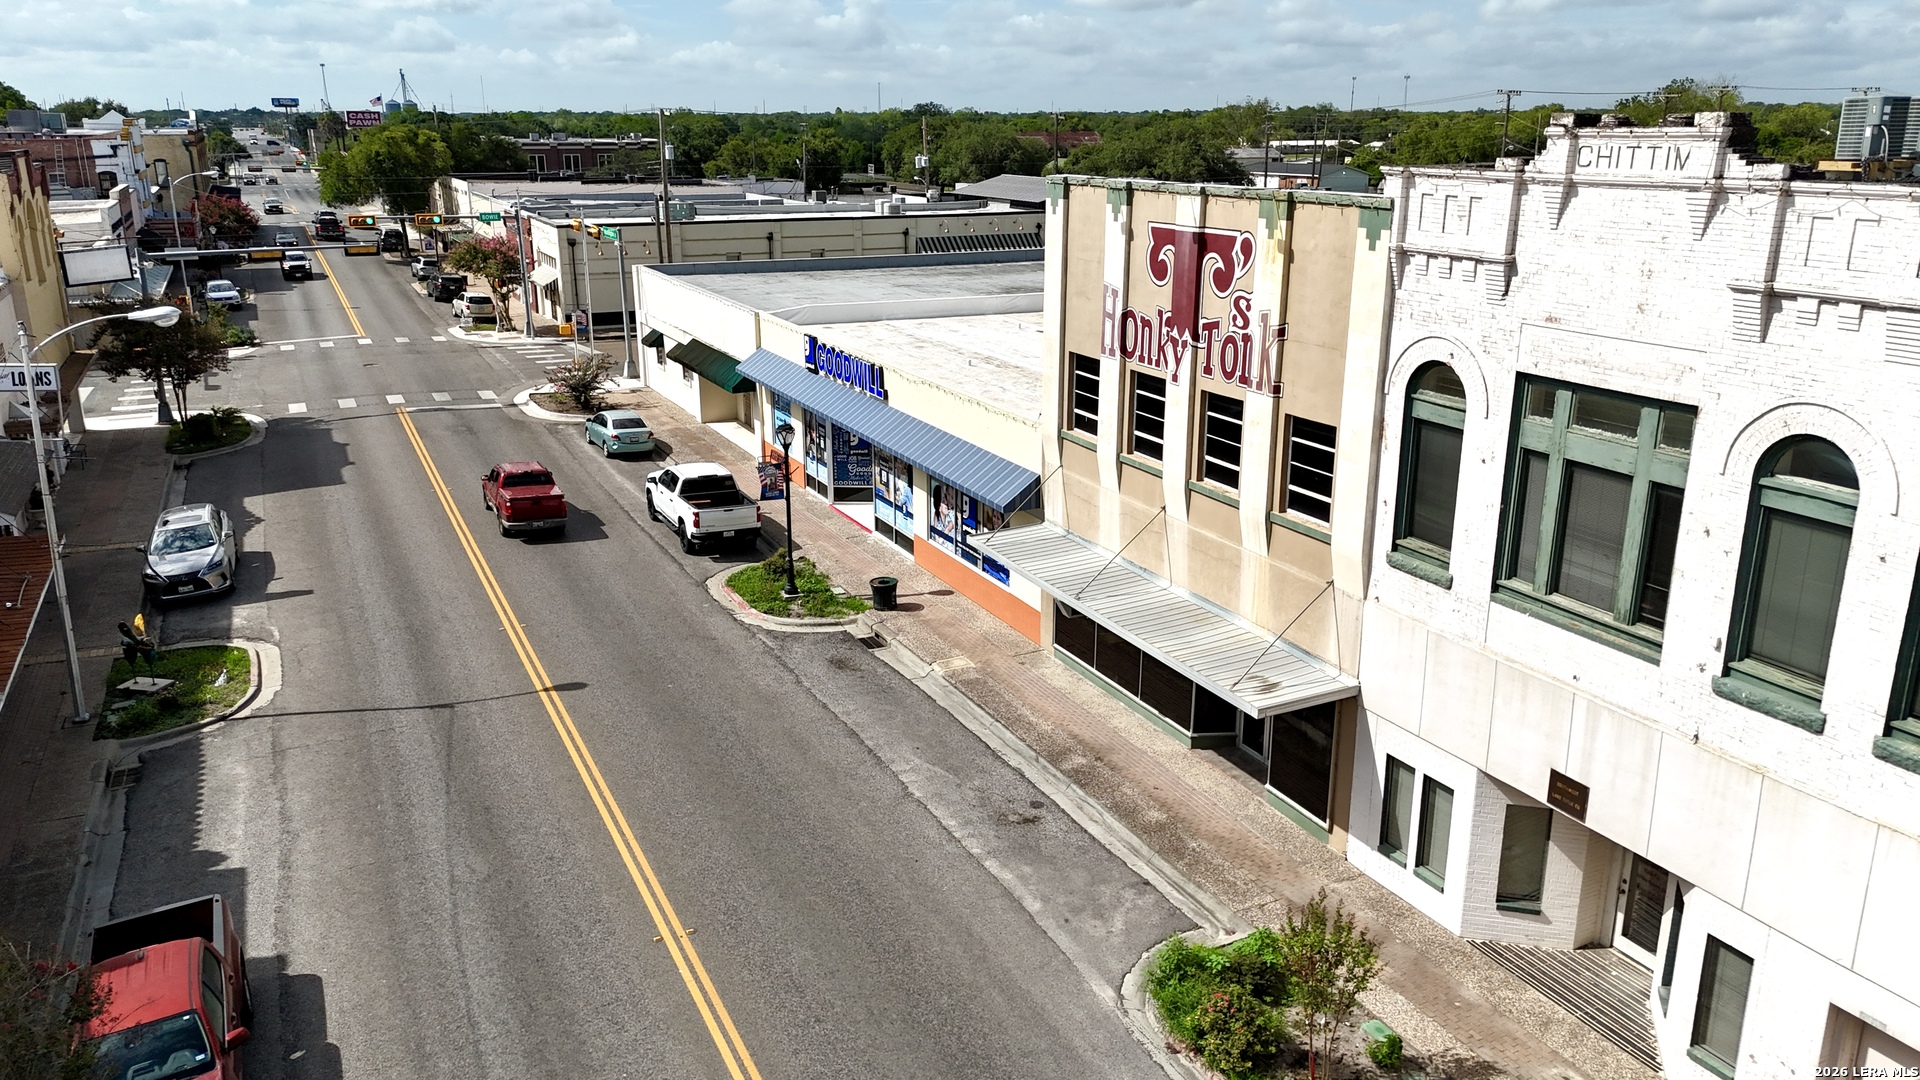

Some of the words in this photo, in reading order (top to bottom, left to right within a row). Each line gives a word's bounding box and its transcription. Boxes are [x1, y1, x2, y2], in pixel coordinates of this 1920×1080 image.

[1577, 145, 1692, 171] CHITTIM
[1101, 281, 1192, 386] Honky
[1200, 309, 1289, 398] Tonk
[11, 371, 52, 387] LONS
[816, 343, 884, 400] GOODWILL
